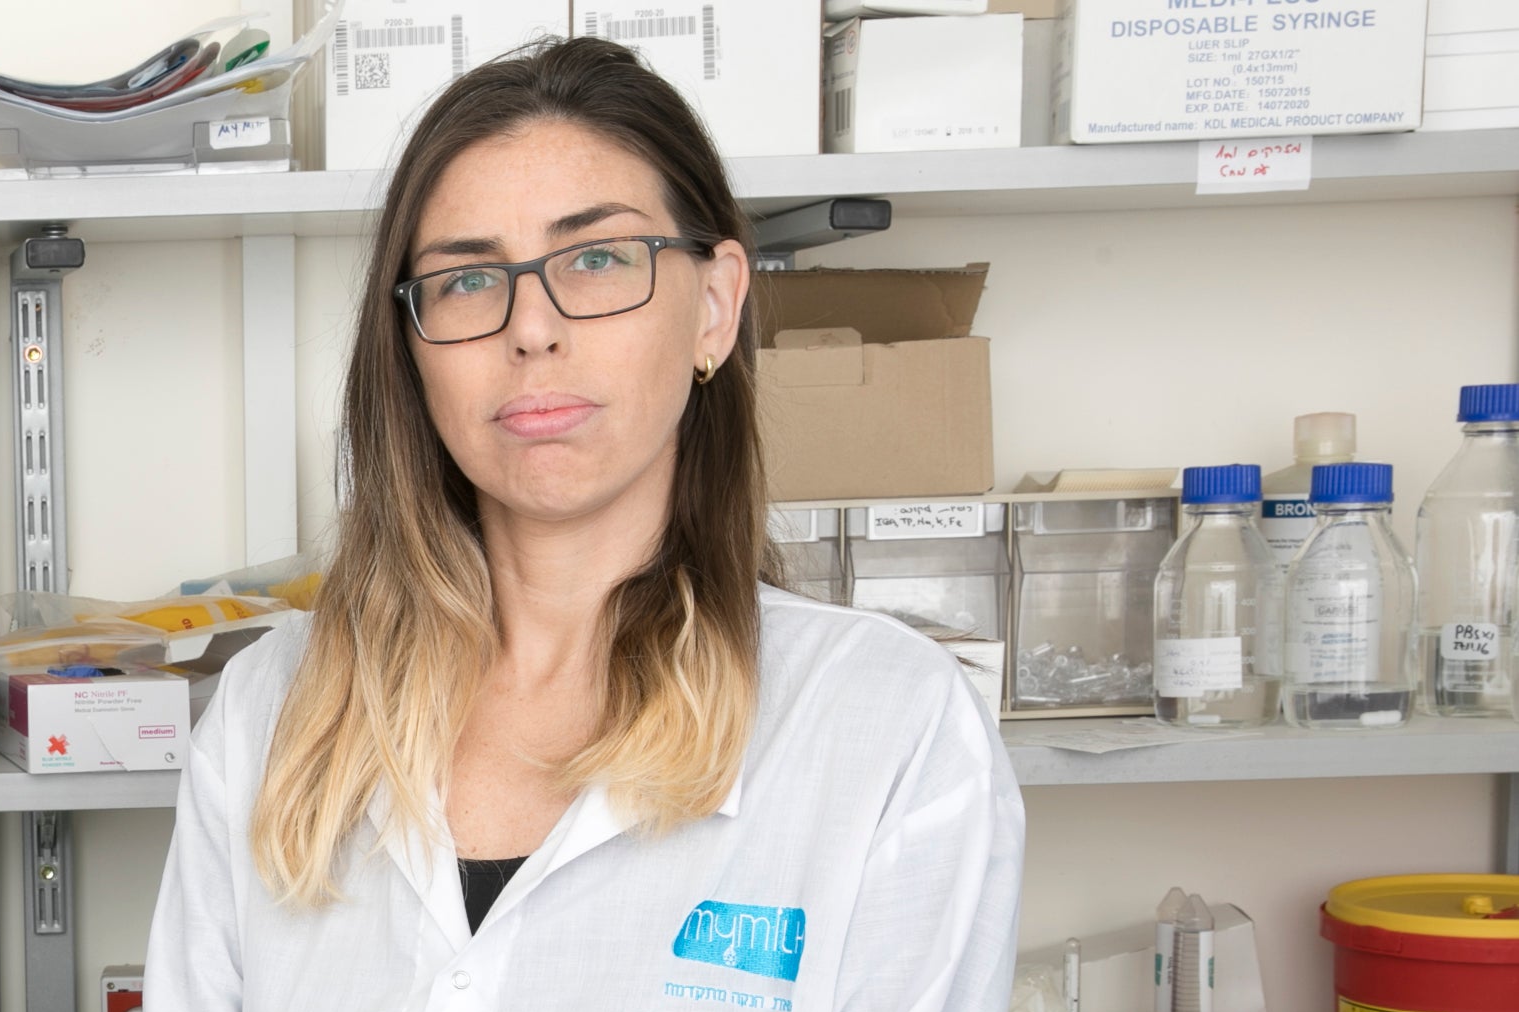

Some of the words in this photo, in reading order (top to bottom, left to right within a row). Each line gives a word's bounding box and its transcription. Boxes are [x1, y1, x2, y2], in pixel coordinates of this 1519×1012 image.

[384, 18, 414, 26] P200-20
[1111, 15, 1258, 38] DISPOSABLE
[1272, 9, 1376, 31] SYRINGE
[1188, 40, 1220, 50] LUER
[1224, 38, 1250, 49] SLIP
[1222, 52, 1241, 62] 1ml
[1232, 62, 1298, 75] (0.4x13mm)
[1186, 78, 1210, 88] LOT
[1245, 75, 1284, 86] 150715
[1258, 87, 1311, 98] 15072015
[1185, 103, 1210, 114] EXP.
[1257, 100, 1310, 111] 14072020
[1088, 121, 1163, 135] Manufactured
[1165, 120, 1198, 132] name:
[1204, 116, 1229, 129] KDL
[1231, 115, 1282, 129] MEDICAL
[1285, 113, 1342, 127] PRODUCT
[1346, 112, 1404, 125] COMPANY
[91, 691, 114, 699] Nitrile
[141, 727, 174, 735] medium
